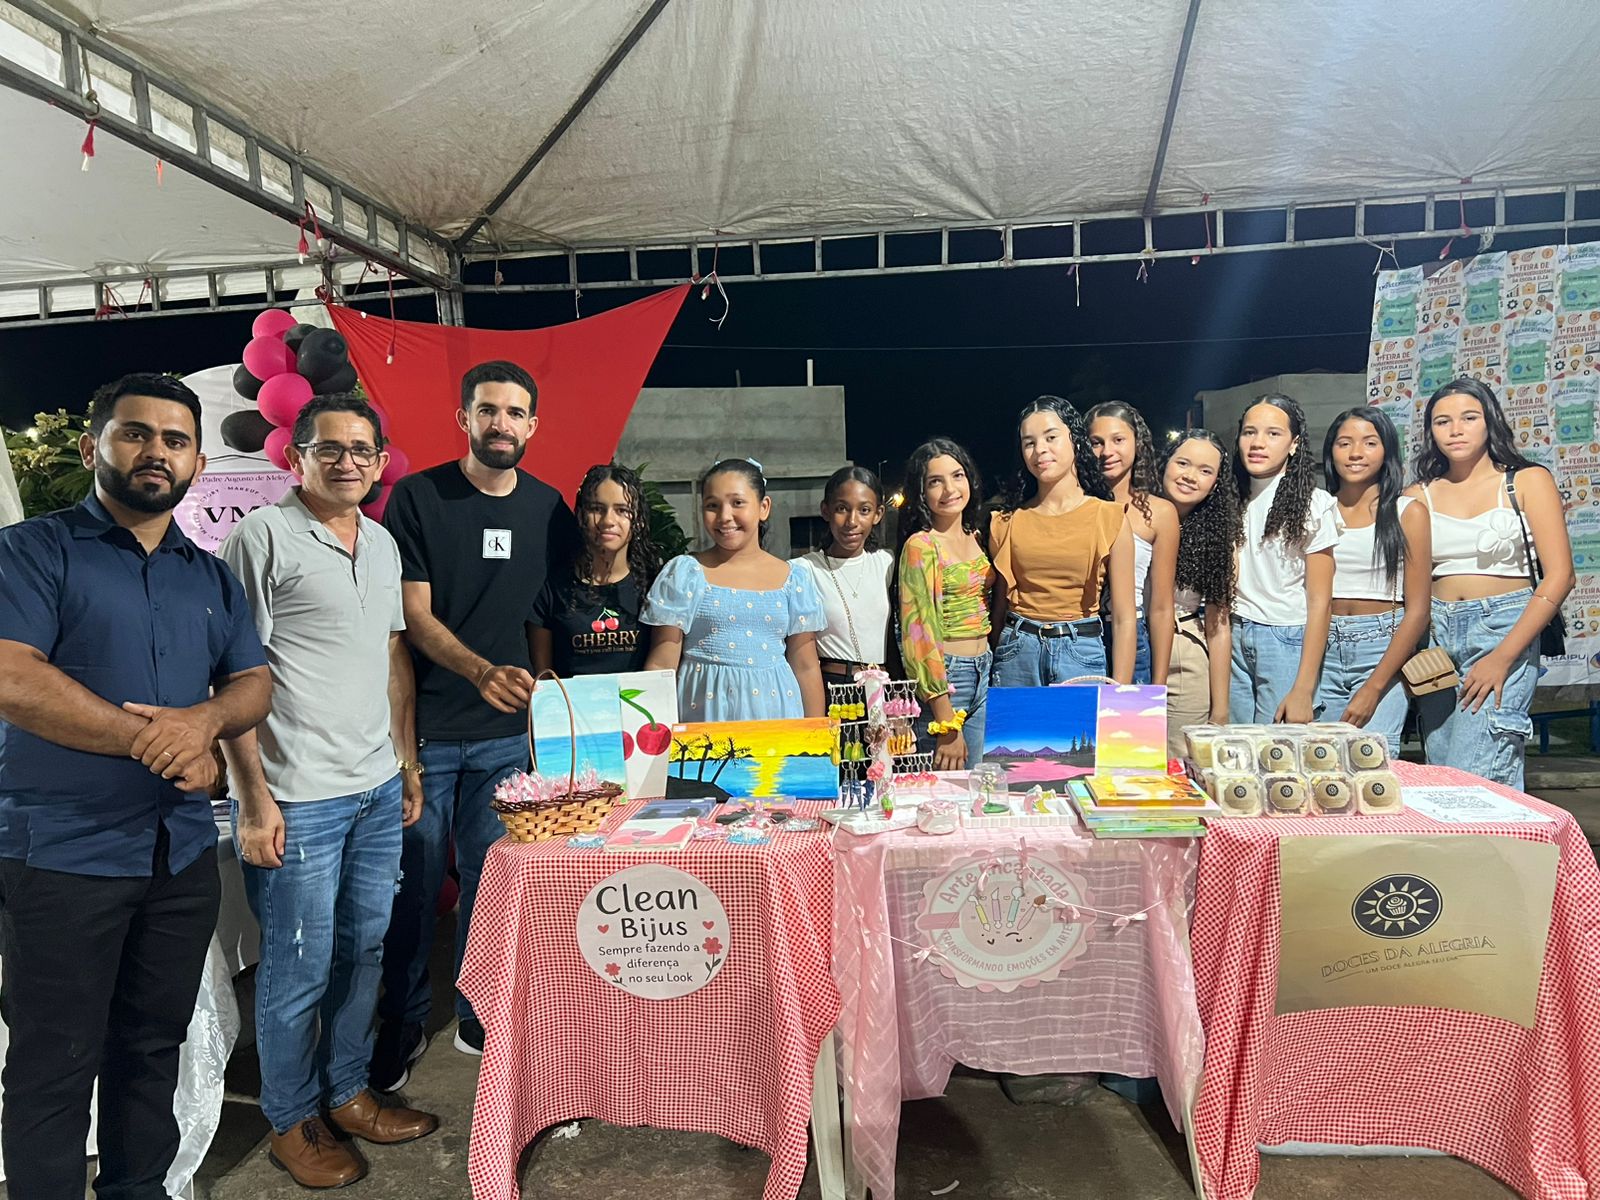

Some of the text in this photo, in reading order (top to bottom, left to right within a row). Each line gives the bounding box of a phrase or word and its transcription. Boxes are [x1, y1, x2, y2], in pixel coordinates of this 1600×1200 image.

[228, 486, 259, 494] MAKEUP
[572, 630, 640, 648] CHERRY
[939, 872, 977, 904] Arte
[596, 883, 698, 915] Clean
[621, 918, 688, 942] Bijus
[598, 945, 642, 957] Sempre
[645, 942, 690, 953] fazendo
[943, 922, 1073, 972] TRANSFORMANDO EMOÇÕES EM ARTE
[627, 959, 679, 969] diferença
[1321, 936, 1497, 978] DOCES DA ALEGRIA
[1380, 963, 1401, 972] DOCE
[629, 975, 642, 983] no
[666, 972, 693, 982] Look
